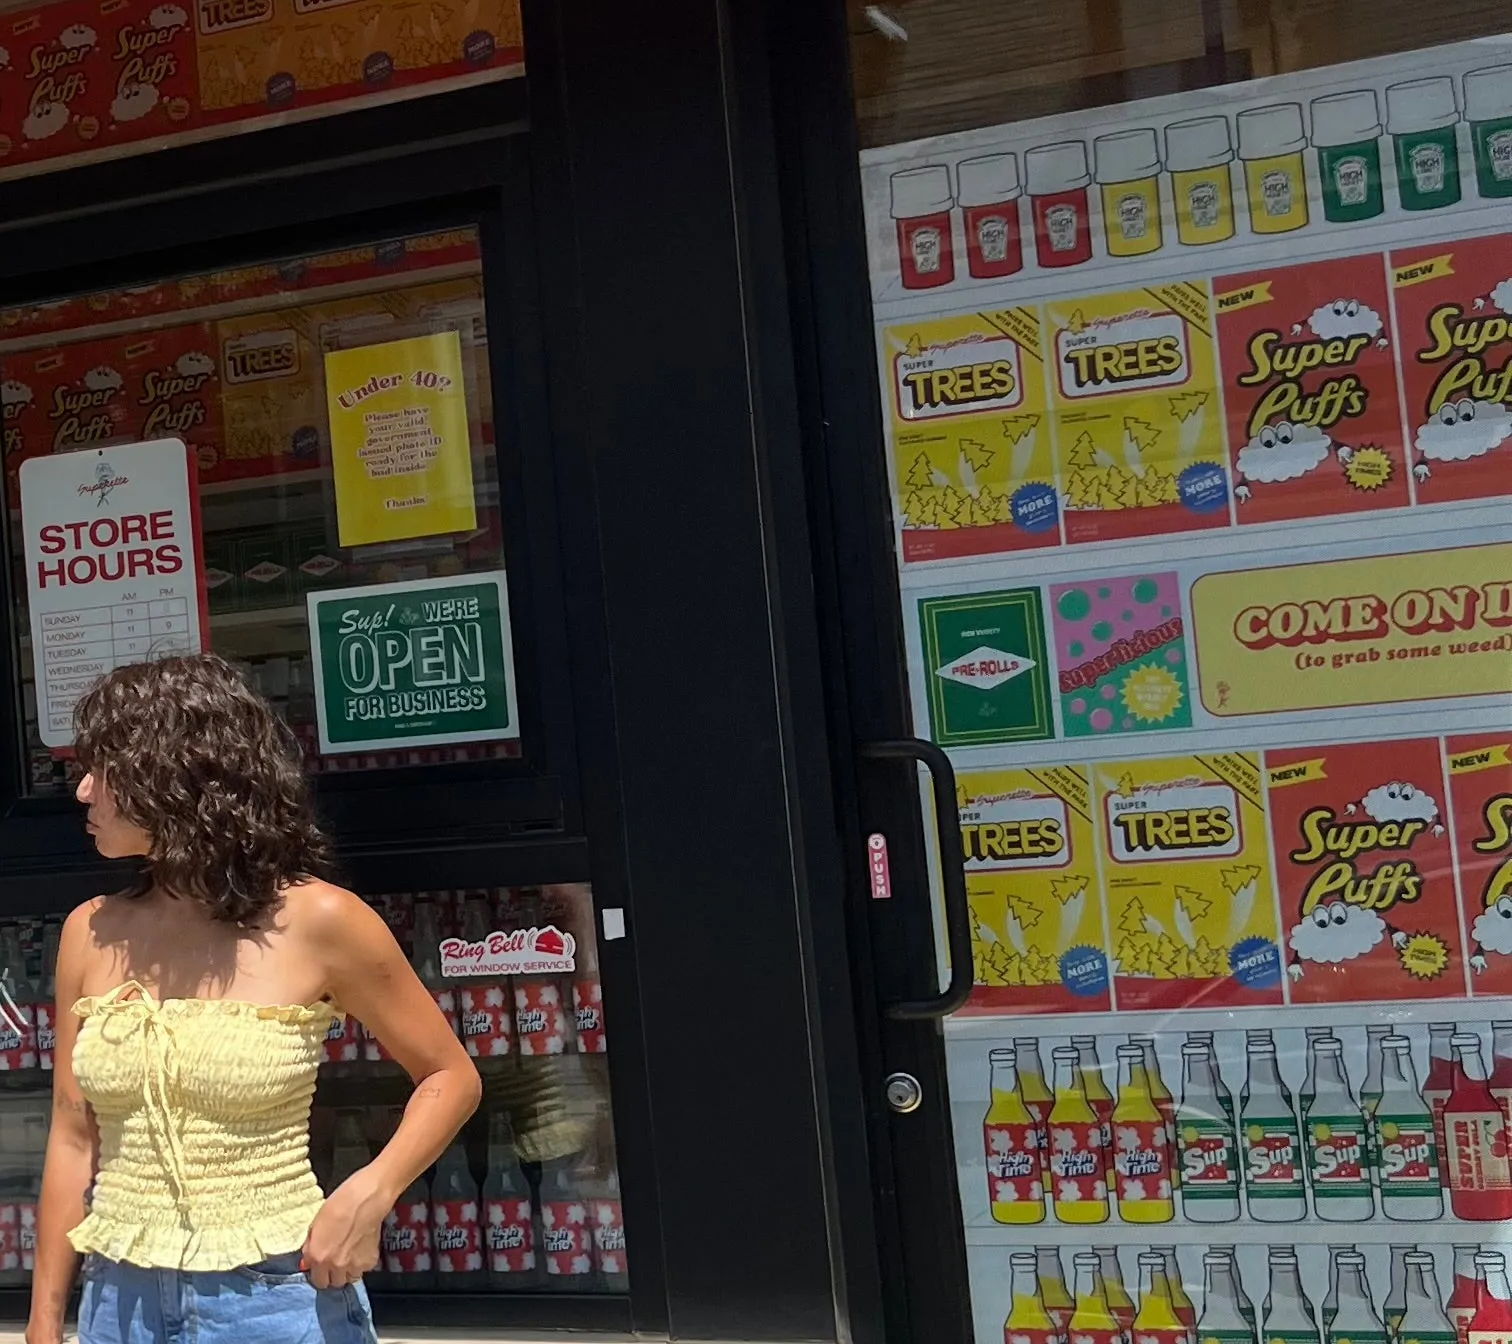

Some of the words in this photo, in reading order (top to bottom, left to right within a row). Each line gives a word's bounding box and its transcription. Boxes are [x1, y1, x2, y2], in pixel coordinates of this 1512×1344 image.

[115, 24, 180, 58] Super
[27, 46, 89, 78] Super
[119, 54, 177, 93] Puffs
[32, 72, 87, 111] Puffs
[1415, 157, 1439, 170] HIGH
[1339, 170, 1363, 182] HIGH
[1264, 182, 1288, 194] HIGH
[1192, 193, 1217, 206] HIGH
[1121, 206, 1143, 218] HIGH
[1051, 217, 1073, 230] HIGH
[915, 239, 936, 251] HIGH
[982, 229, 1005, 241] HIGH
[1396, 263, 1434, 282] NEW
[1218, 290, 1254, 308] NEW
[1065, 335, 1097, 348] SUPER
[226, 345, 296, 376] TREES
[903, 359, 933, 370] SUPER
[1064, 336, 1183, 387] TREES
[1239, 329, 1372, 385] Super
[139, 370, 207, 404] Super
[337, 375, 402, 408] Under
[411, 370, 452, 392] 40?
[903, 360, 1015, 410] TREES
[51, 385, 114, 417] Super
[1247, 374, 1368, 438] Puffs
[365, 411, 400, 423] Please
[404, 407, 429, 416] have
[367, 429, 431, 446] government
[1185, 474, 1222, 497] MORE
[1017, 495, 1053, 515] MORE
[39, 510, 175, 553] STORE
[38, 544, 183, 589] HOURS
[122, 593, 137, 601] AM
[159, 588, 173, 597] PM
[45, 615, 81, 627] SUNDAY
[339, 603, 396, 635] Sup!
[422, 597, 479, 622] WE'RE
[1234, 595, 1389, 650] COME
[1392, 584, 1479, 635] ON
[47, 631, 84, 643] MONDAY
[48, 648, 87, 659] TUESDAY
[339, 622, 485, 693] OPEN
[1295, 651, 1324, 670] (to
[1331, 647, 1381, 669] grab
[1386, 644, 1442, 661] some
[48, 663, 103, 676] WEDNESDAY
[952, 659, 1019, 677] PRE-ROLLS
[345, 694, 385, 720] FOR
[388, 686, 486, 717] BUSINESS
[1451, 752, 1490, 768] NEW
[1271, 766, 1306, 782] NEW
[1115, 801, 1147, 811] SUPER
[1113, 806, 1233, 852] TREES
[1290, 806, 1427, 864] Super
[961, 818, 1064, 863] TREES
[873, 852, 887, 897] PUSH
[1301, 860, 1423, 917] Puffs
[443, 941, 485, 963] Ring
[488, 933, 524, 954] Bell
[445, 965, 467, 974] FOR
[470, 963, 520, 972] WINDOW
[523, 960, 572, 970] SERVICE
[1067, 959, 1101, 980] MORE
[1237, 950, 1274, 971] MORE
[997, 1148, 1033, 1167] High
[1060, 1148, 1097, 1167] High
[1124, 1147, 1159, 1166] High
[1182, 1144, 1229, 1177] Sup
[1247, 1144, 1294, 1177] Sup
[1313, 1143, 1360, 1175] Sup
[1381, 1141, 1430, 1174] Sup
[1453, 1120, 1474, 1190] SUPER
[998, 1160, 1034, 1178] Time
[1062, 1159, 1098, 1178] Time
[1126, 1158, 1162, 1176] Time
